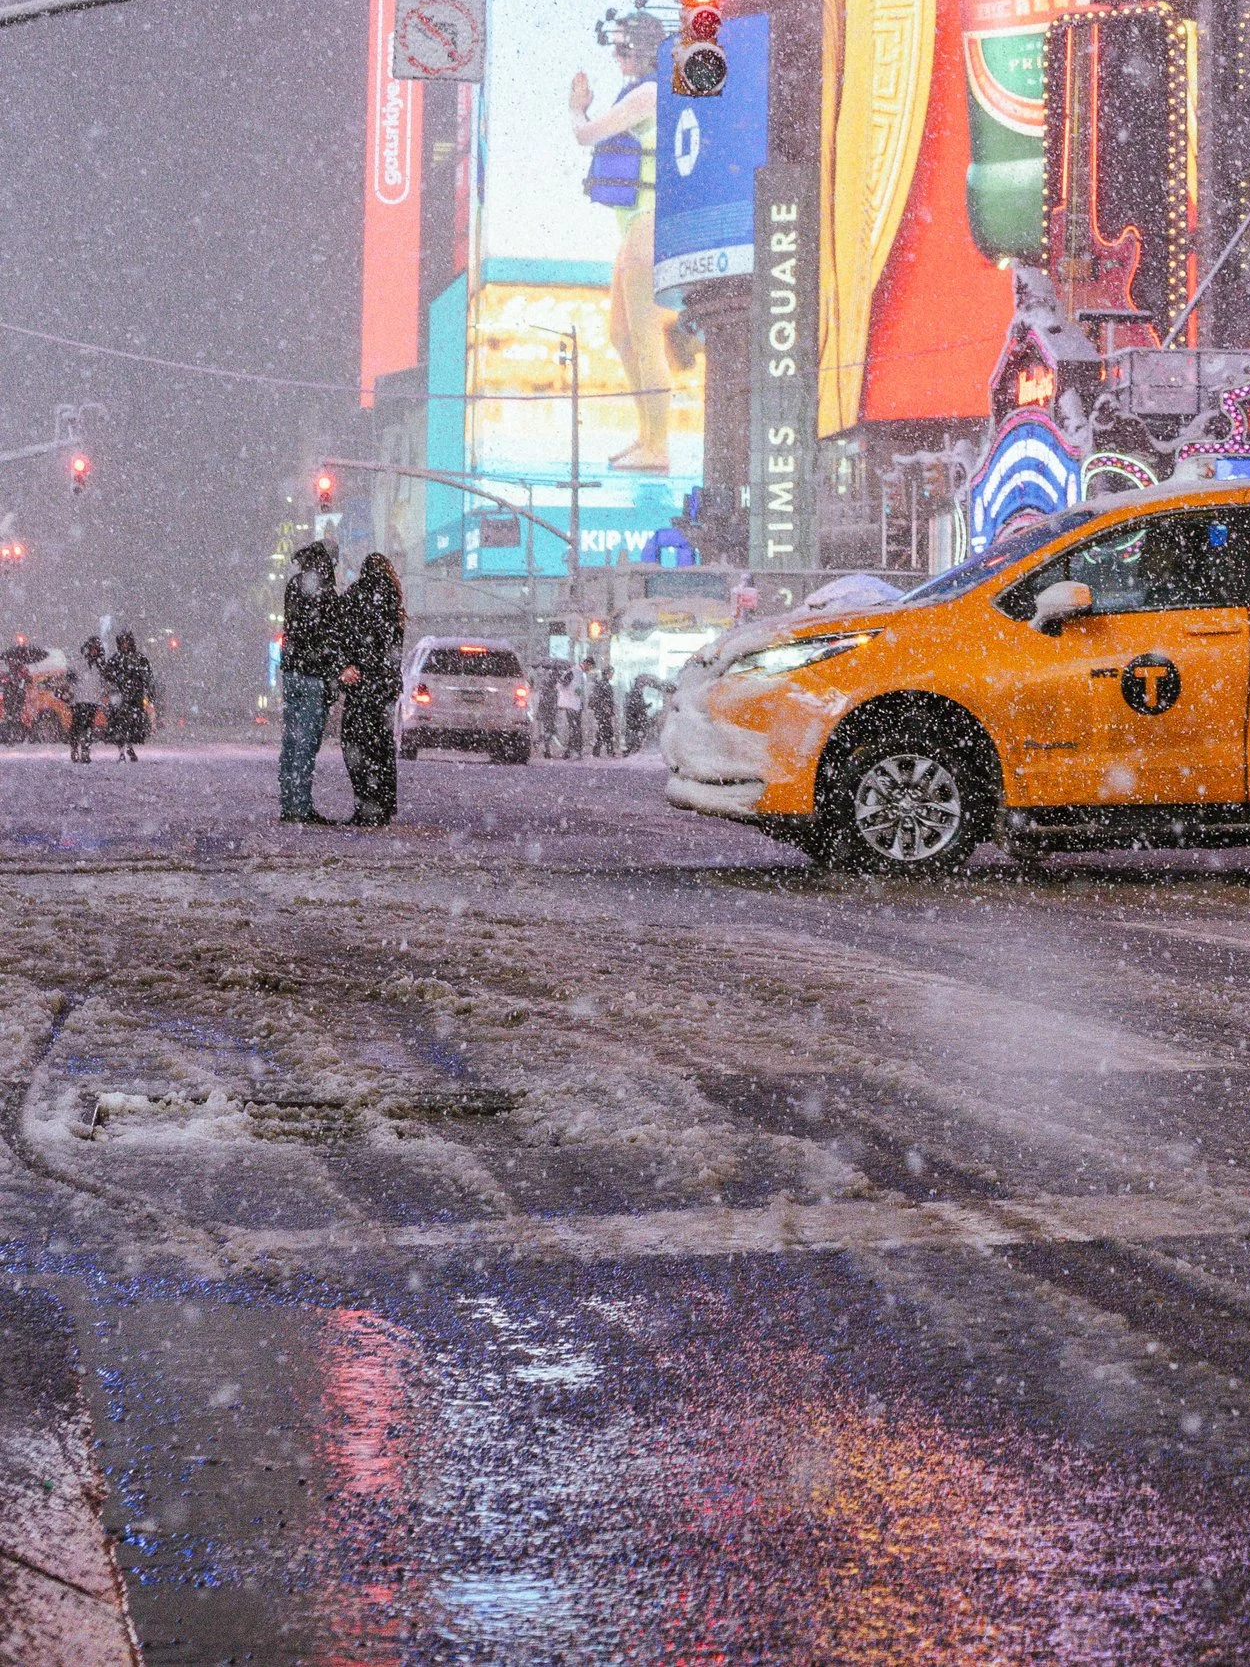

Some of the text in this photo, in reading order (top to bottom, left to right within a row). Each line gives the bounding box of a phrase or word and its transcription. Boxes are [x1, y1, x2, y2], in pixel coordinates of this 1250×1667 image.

[680, 255, 714, 278] CHASE
[768, 202, 798, 378] SQUARE
[767, 424, 796, 559] TIMES
[566, 529, 621, 552] KIP
[1090, 667, 1119, 679] NYC
